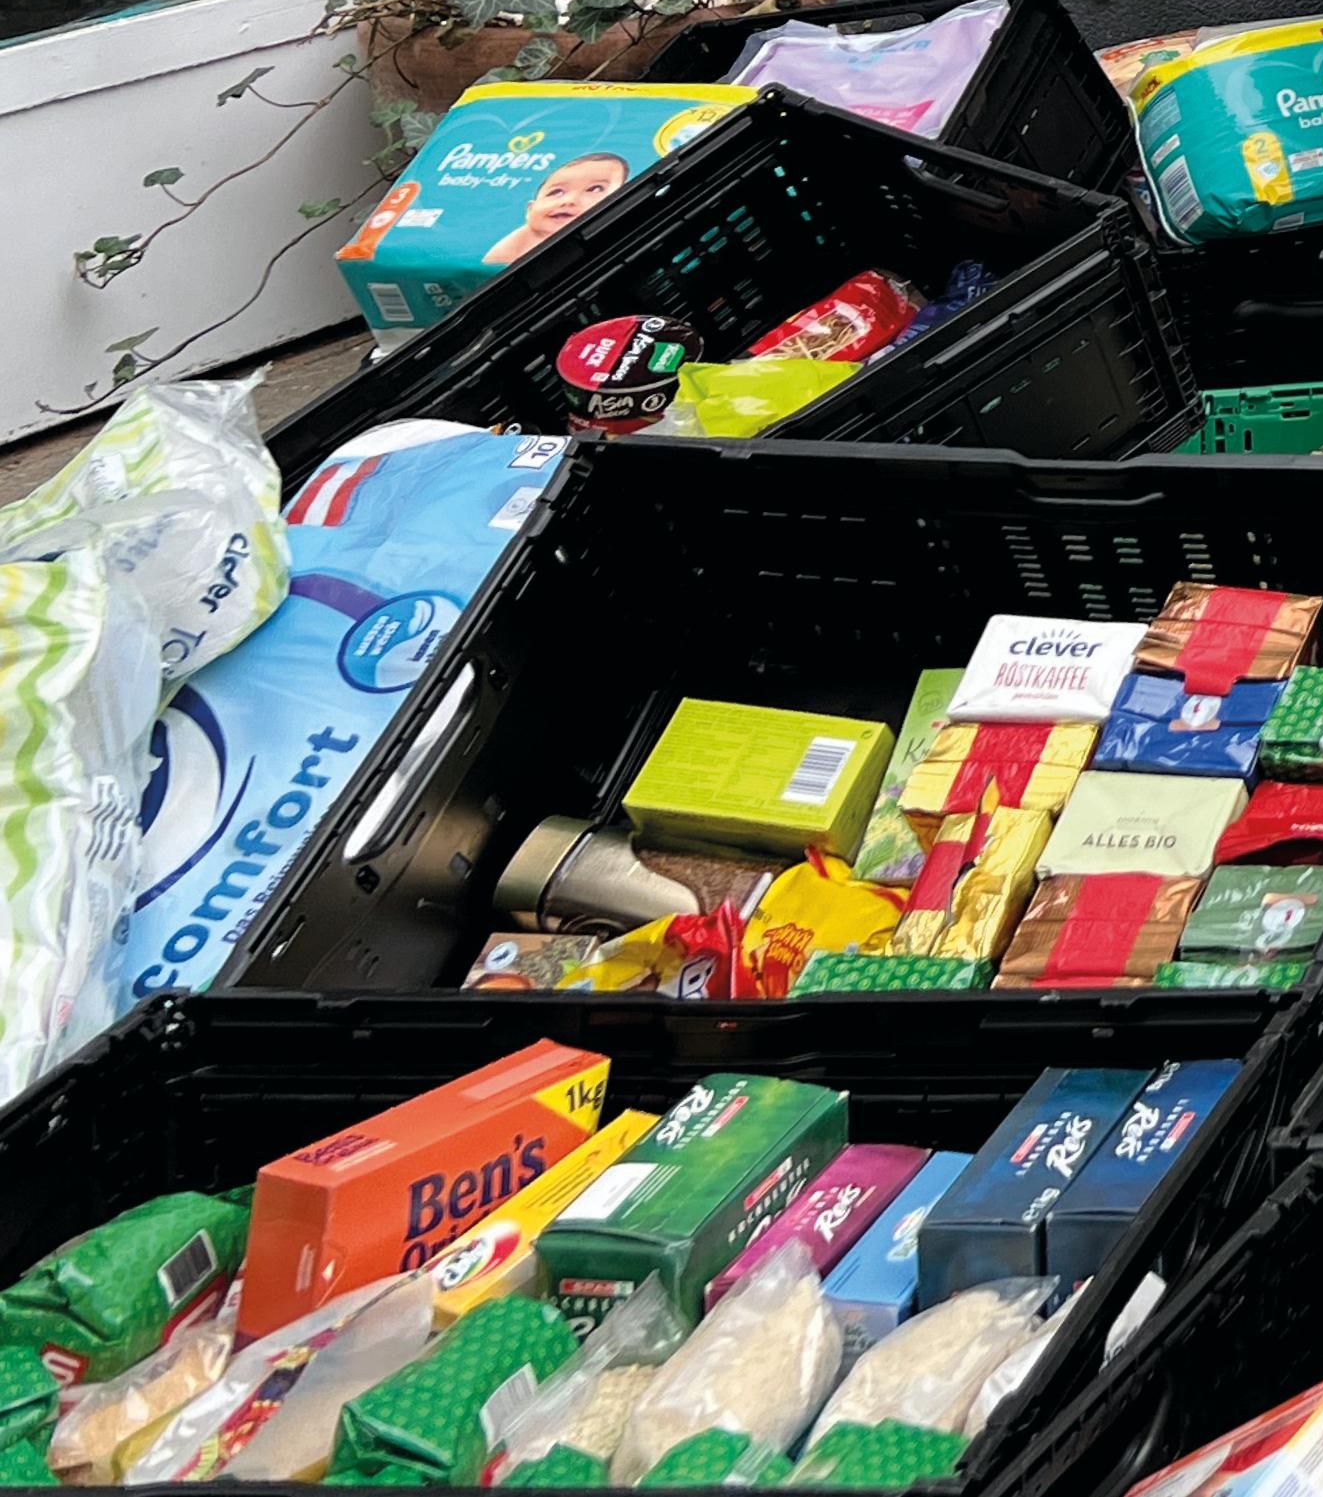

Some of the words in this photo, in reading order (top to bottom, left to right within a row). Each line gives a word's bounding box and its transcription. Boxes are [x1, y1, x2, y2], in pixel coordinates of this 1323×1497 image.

[437, 143, 556, 173] Pampers
[588, 337, 617, 366] DUCK
[207, 531, 250, 614] clever
[1009, 635, 1102, 658] clever
[994, 662, 1091, 691] RÖSTKAFFEE
[1082, 833, 1139, 849] ALLES
[1144, 834, 1178, 850] BIO
[131, 725, 359, 1000] comfort
[403, 1133, 548, 1245] Ben's
